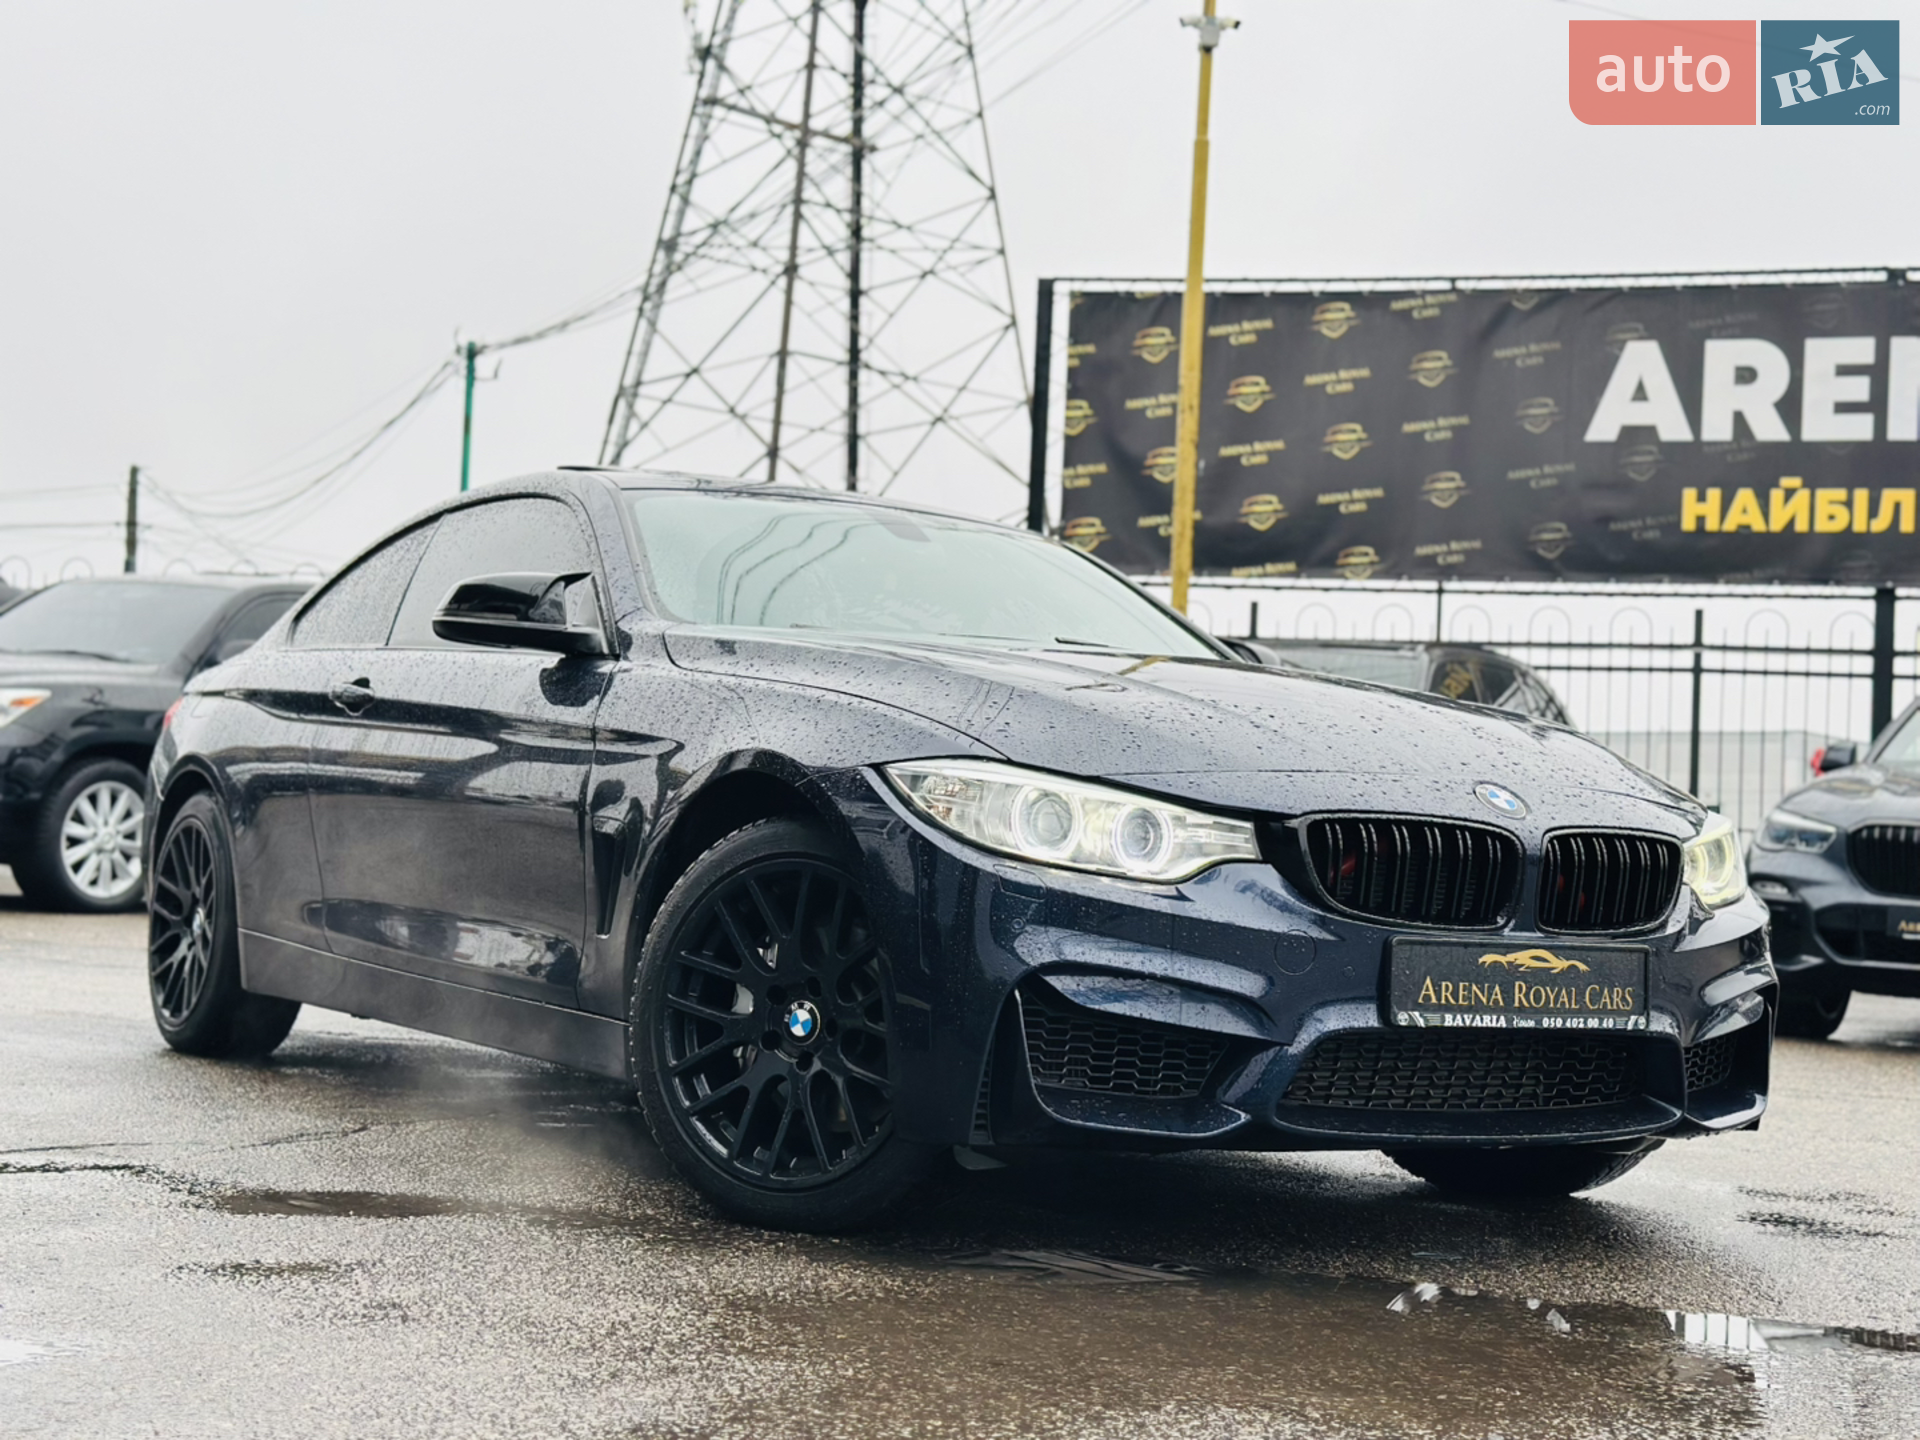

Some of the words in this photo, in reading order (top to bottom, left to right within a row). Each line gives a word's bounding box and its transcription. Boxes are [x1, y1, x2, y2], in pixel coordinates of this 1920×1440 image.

[1681, 476, 1916, 533] НАЙБІЛ
[1418, 976, 1504, 1006] ARENA
[1513, 981, 1579, 1009] ROYAL
[1585, 984, 1634, 1011] CARS
[1444, 1015, 1506, 1028] BAVARIA
